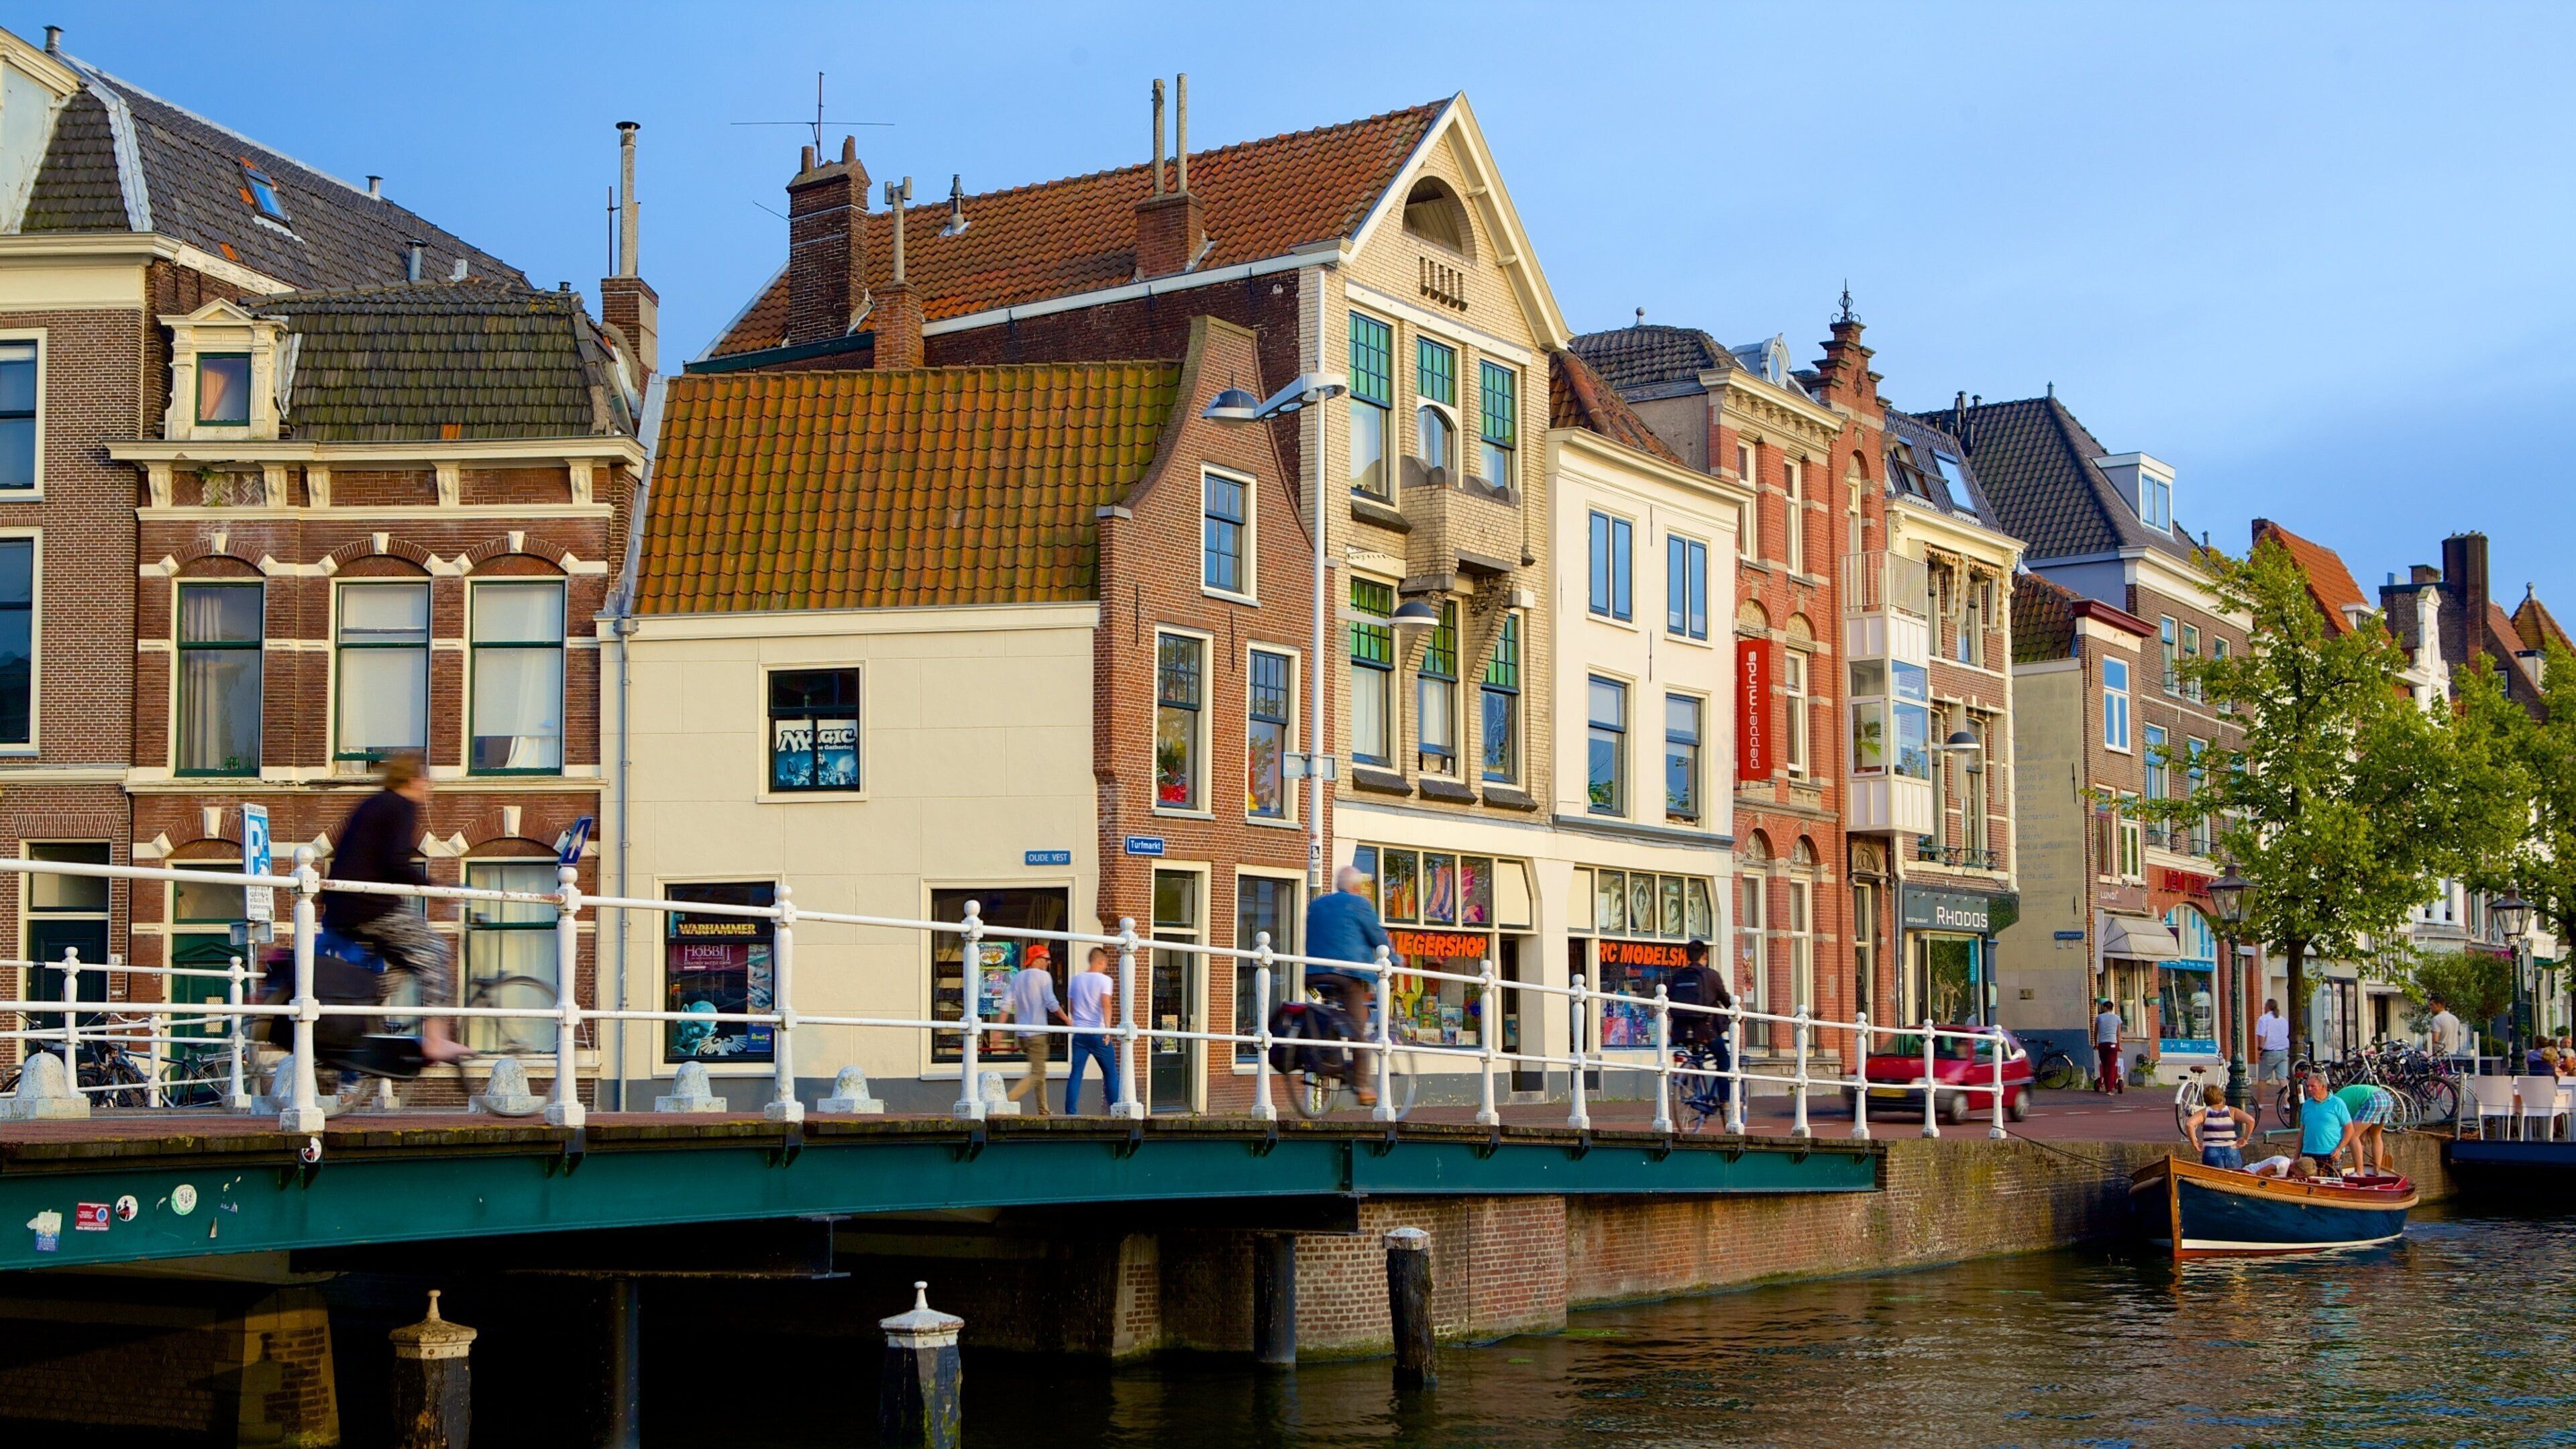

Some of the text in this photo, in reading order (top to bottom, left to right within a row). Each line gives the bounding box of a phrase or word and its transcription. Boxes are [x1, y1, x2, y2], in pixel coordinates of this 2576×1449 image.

[1746, 651, 1760, 769] pepperminds
[1130, 840, 1161, 850] Turfmarkt
[1028, 853, 1067, 862] OUDE VEST
[678, 923, 757, 935] WARHAMMER
[1599, 943, 1688, 967] RC MODELSH
